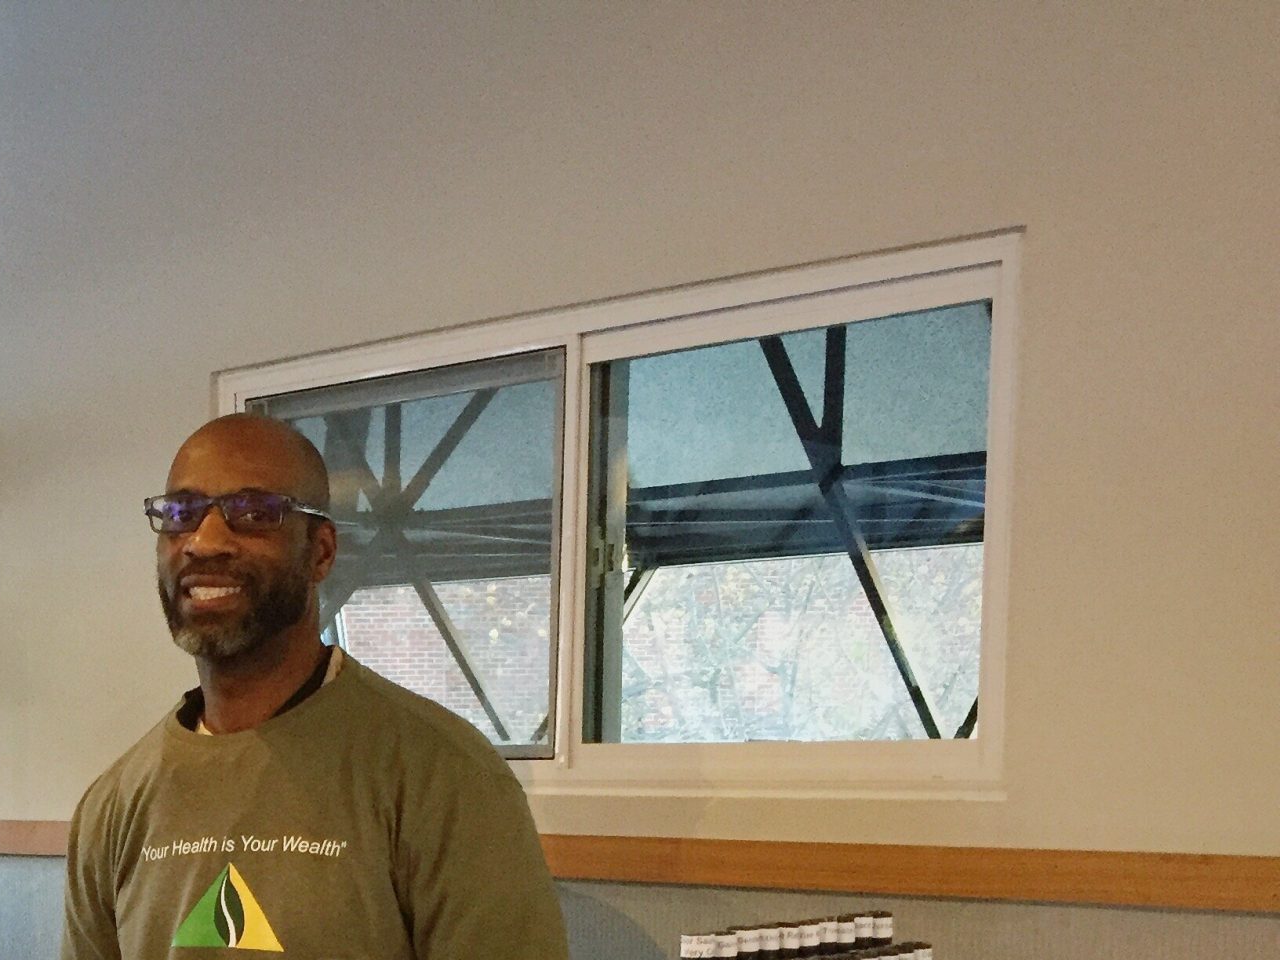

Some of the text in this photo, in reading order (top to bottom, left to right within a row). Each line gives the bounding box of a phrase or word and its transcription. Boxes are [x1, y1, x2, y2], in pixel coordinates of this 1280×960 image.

[172, 837, 217, 856] Health
[221, 836, 235, 852] is
[241, 835, 279, 852] Your
[283, 835, 347, 857] Wealth"
